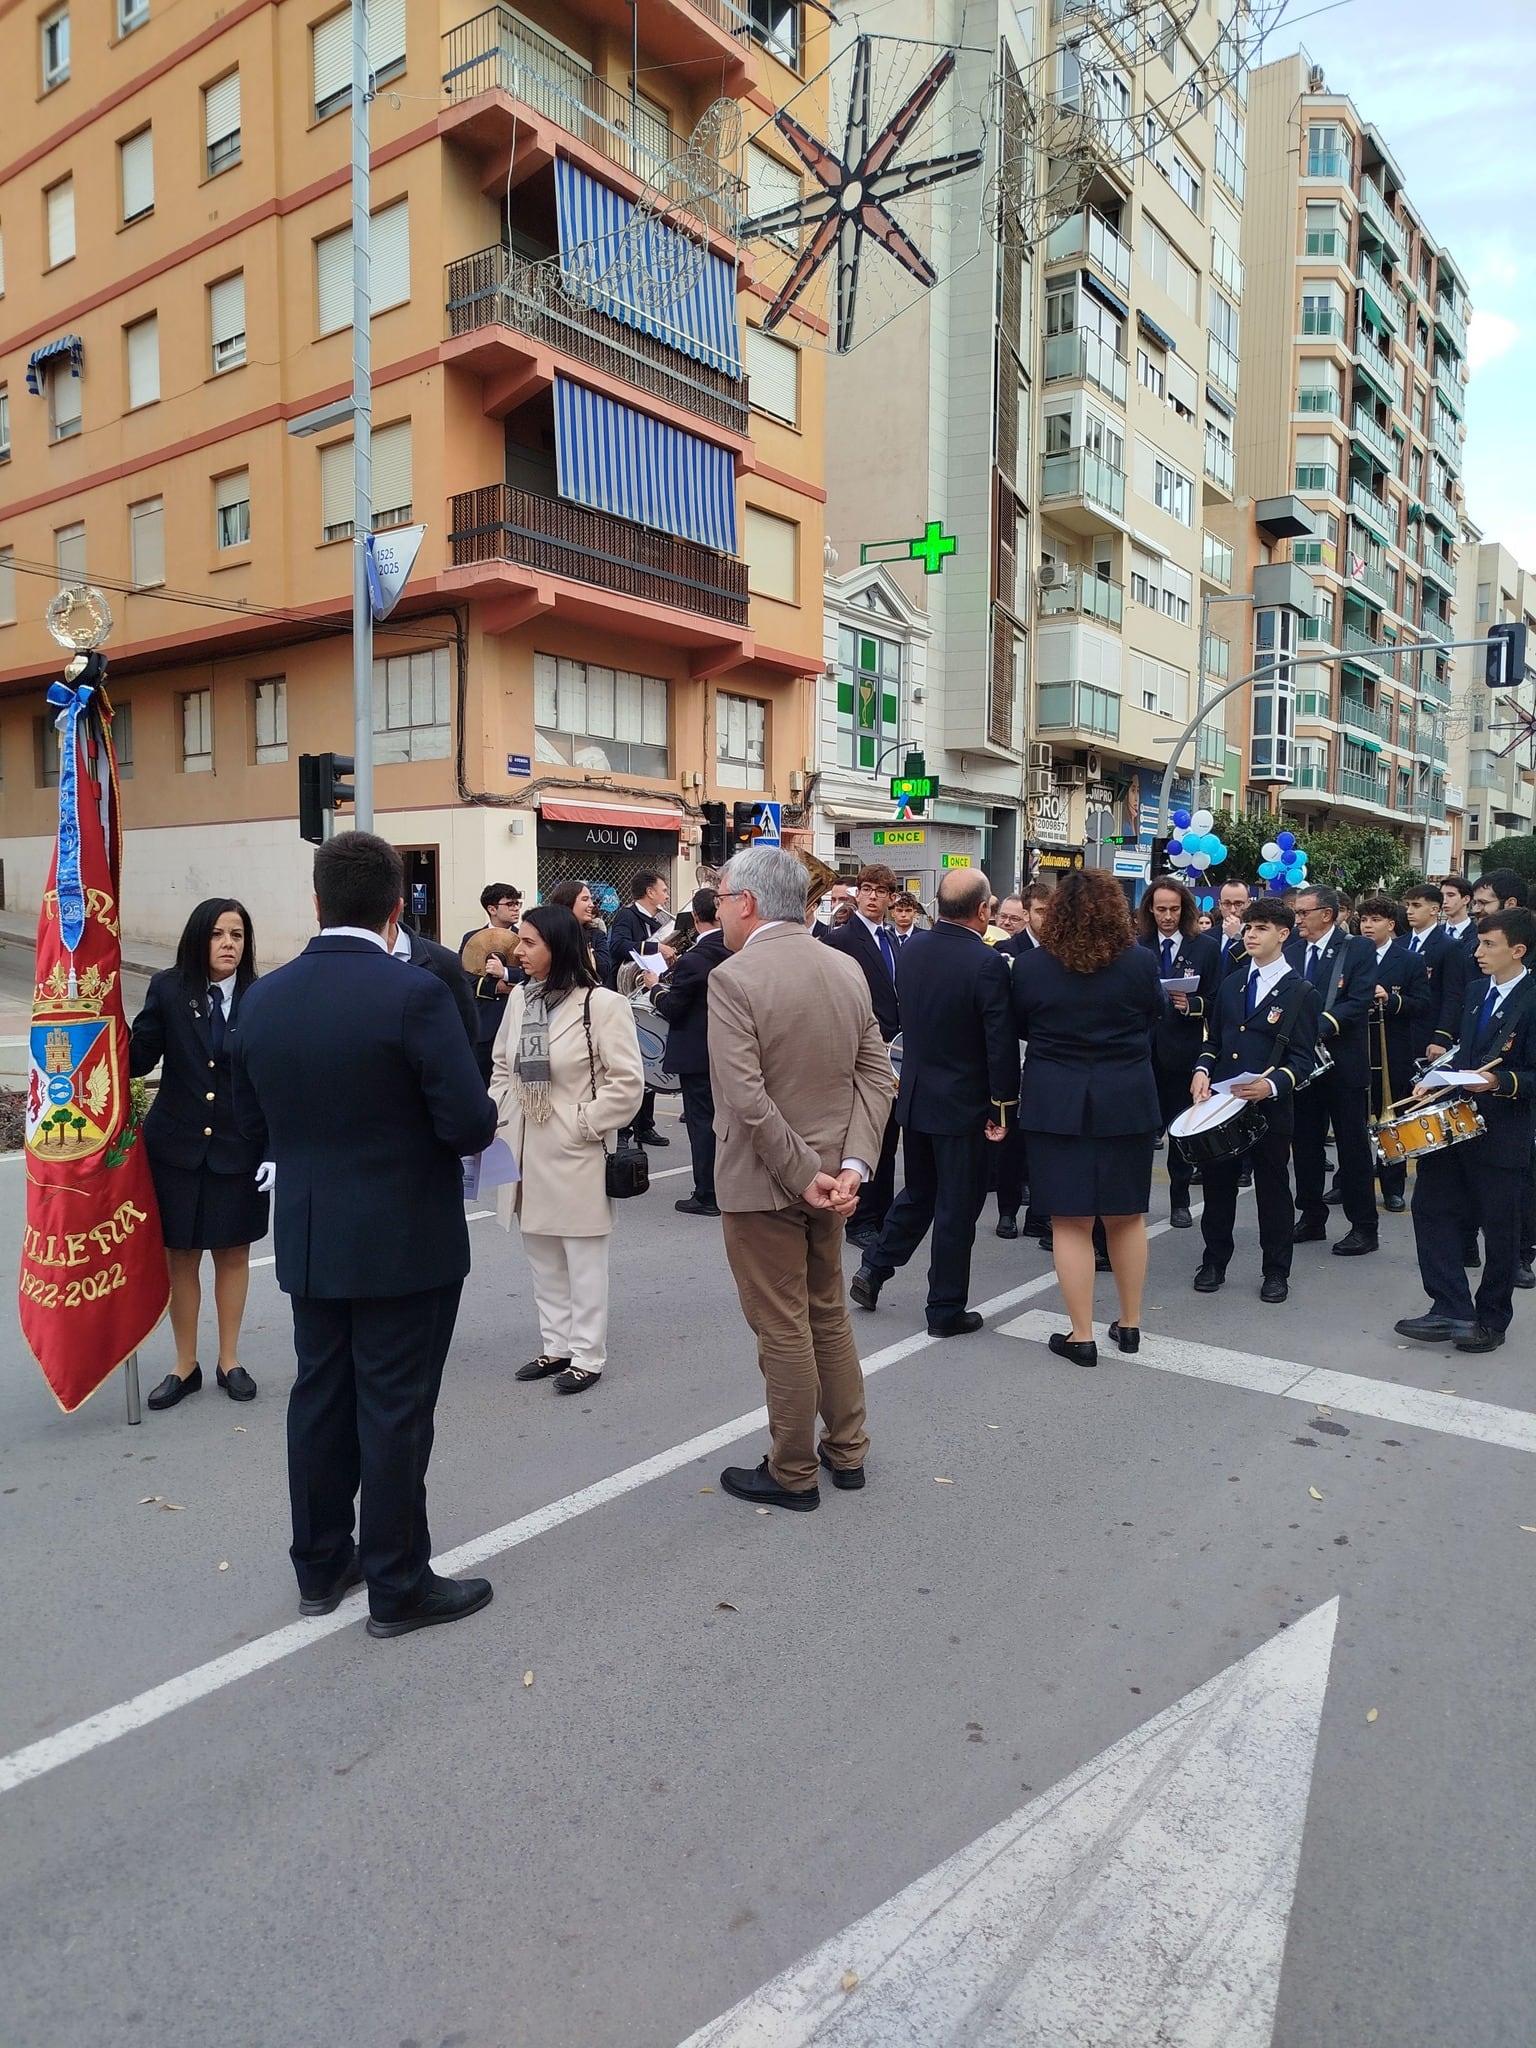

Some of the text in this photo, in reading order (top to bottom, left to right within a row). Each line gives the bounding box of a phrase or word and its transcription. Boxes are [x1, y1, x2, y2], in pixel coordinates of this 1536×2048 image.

[377, 548, 394, 561] 1525
[379, 562, 400, 575] 2025
[888, 832, 920, 842] ONCE
[950, 857, 969, 867] ONCE
[20, 1262, 128, 1309] 1922-2022
